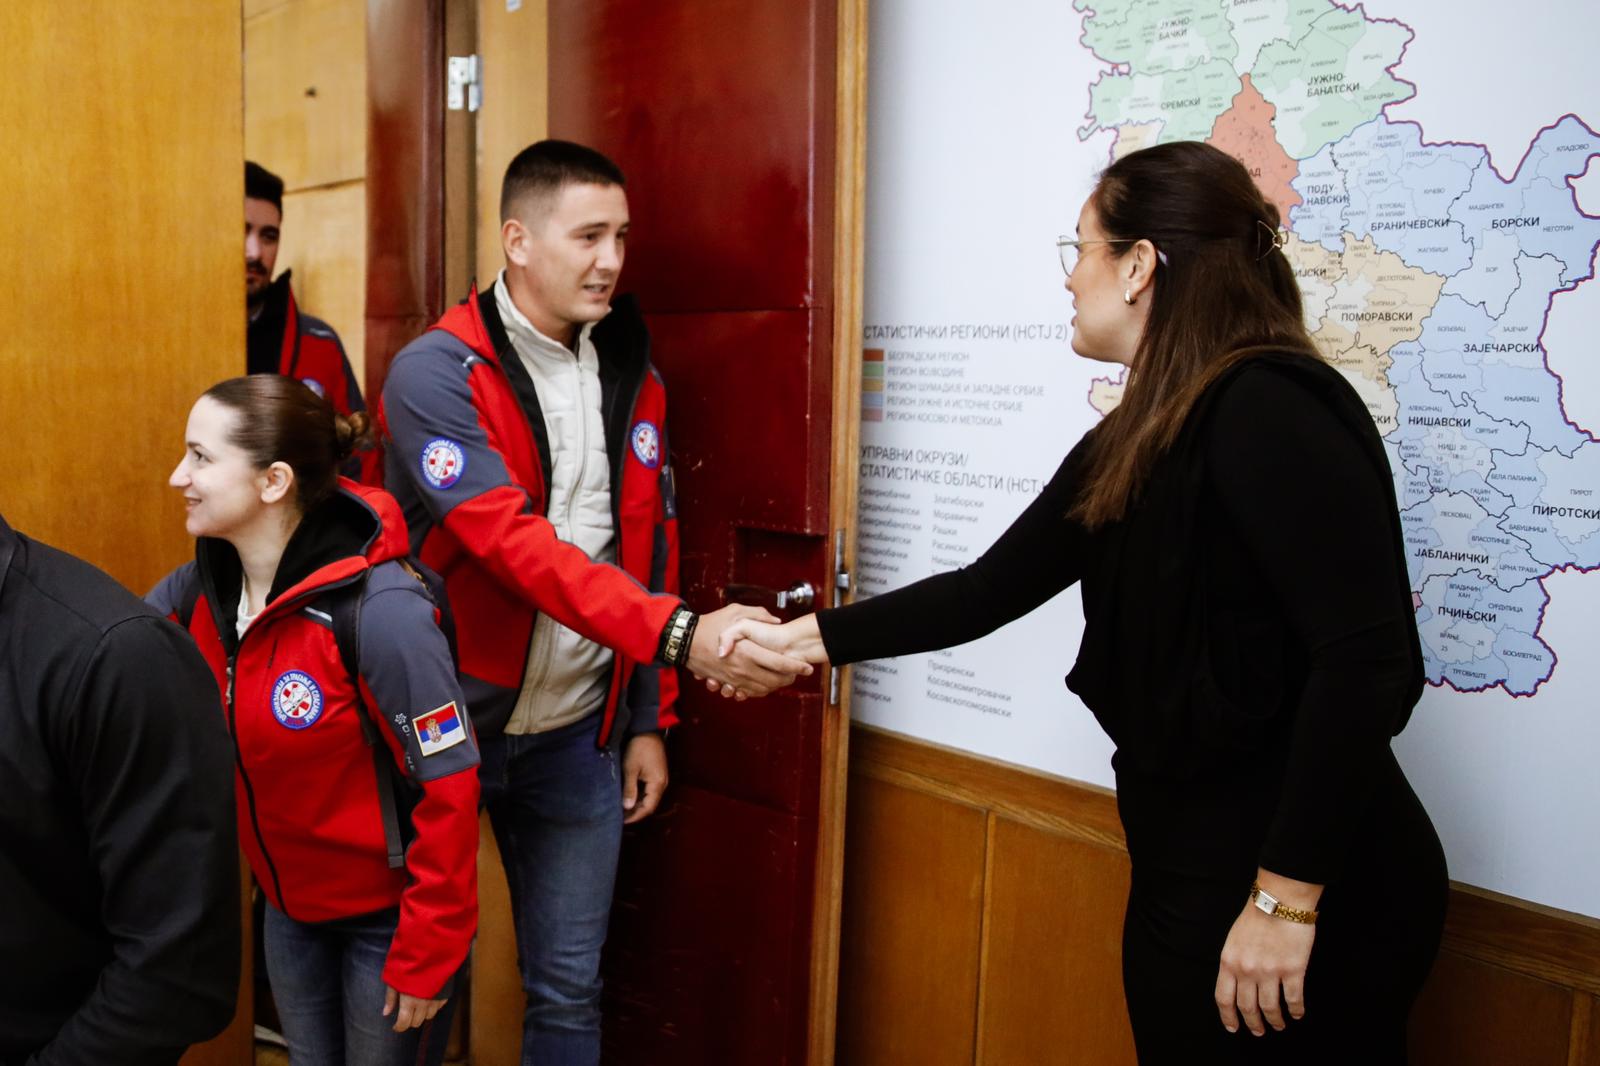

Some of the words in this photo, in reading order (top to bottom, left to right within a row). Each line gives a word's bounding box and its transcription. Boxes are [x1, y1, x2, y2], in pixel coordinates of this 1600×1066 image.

[1160, 17, 1192, 30] ЈУЖНО-
[1158, 29, 1188, 40] БАЧКИ
[1308, 73, 1346, 86] ЈУЖНО-
[1307, 83, 1360, 97] БАНАТСКИ
[1160, 99, 1200, 110] СРЕМСКИ
[1307, 195, 1350, 205] НАВСКИ
[1370, 218, 1450, 231] БРАНИЧЕВСКИ
[1492, 217, 1540, 229] БОРСКИ
[1341, 312, 1413, 321] ПОМОРАВСКИ
[864, 325, 947, 340] СТАТИСТИЧКИ
[951, 325, 1009, 340] РЕГИОНИ
[1055, 325, 1068, 342] 2)
[1464, 344, 1539, 352] ЗАЈЕЧАРСКИ
[938, 352, 969, 361] РЕГИОН
[888, 367, 916, 375] РЕГИОН
[887, 382, 916, 391] РЕГИОН
[887, 397, 916, 405] РЕГИОН
[886, 412, 915, 421] РЕГИОН
[1408, 416, 1471, 427] НИШАВСКИ
[861, 446, 913, 462] УПРАВНИ
[916, 450, 968, 466] ОКРУЗИ/
[861, 464, 940, 484] СТАТИСТИЧКЕ
[944, 472, 1003, 489] ОБЛАСТИ
[1440, 511, 1472, 519] ЛЕСКОВАЦ
[1532, 505, 1600, 519] ПИРОТСКИ
[1509, 524, 1547, 533] БАБУШНИЦА
[1414, 548, 1489, 564] ЈАБЛАНИЧКИ
[1438, 607, 1496, 622] ПЧИЊСКИ
[1503, 650, 1542, 661] БОСИЛЕГРАД
[1453, 669, 1487, 679] ТРГОВИШТЕ
